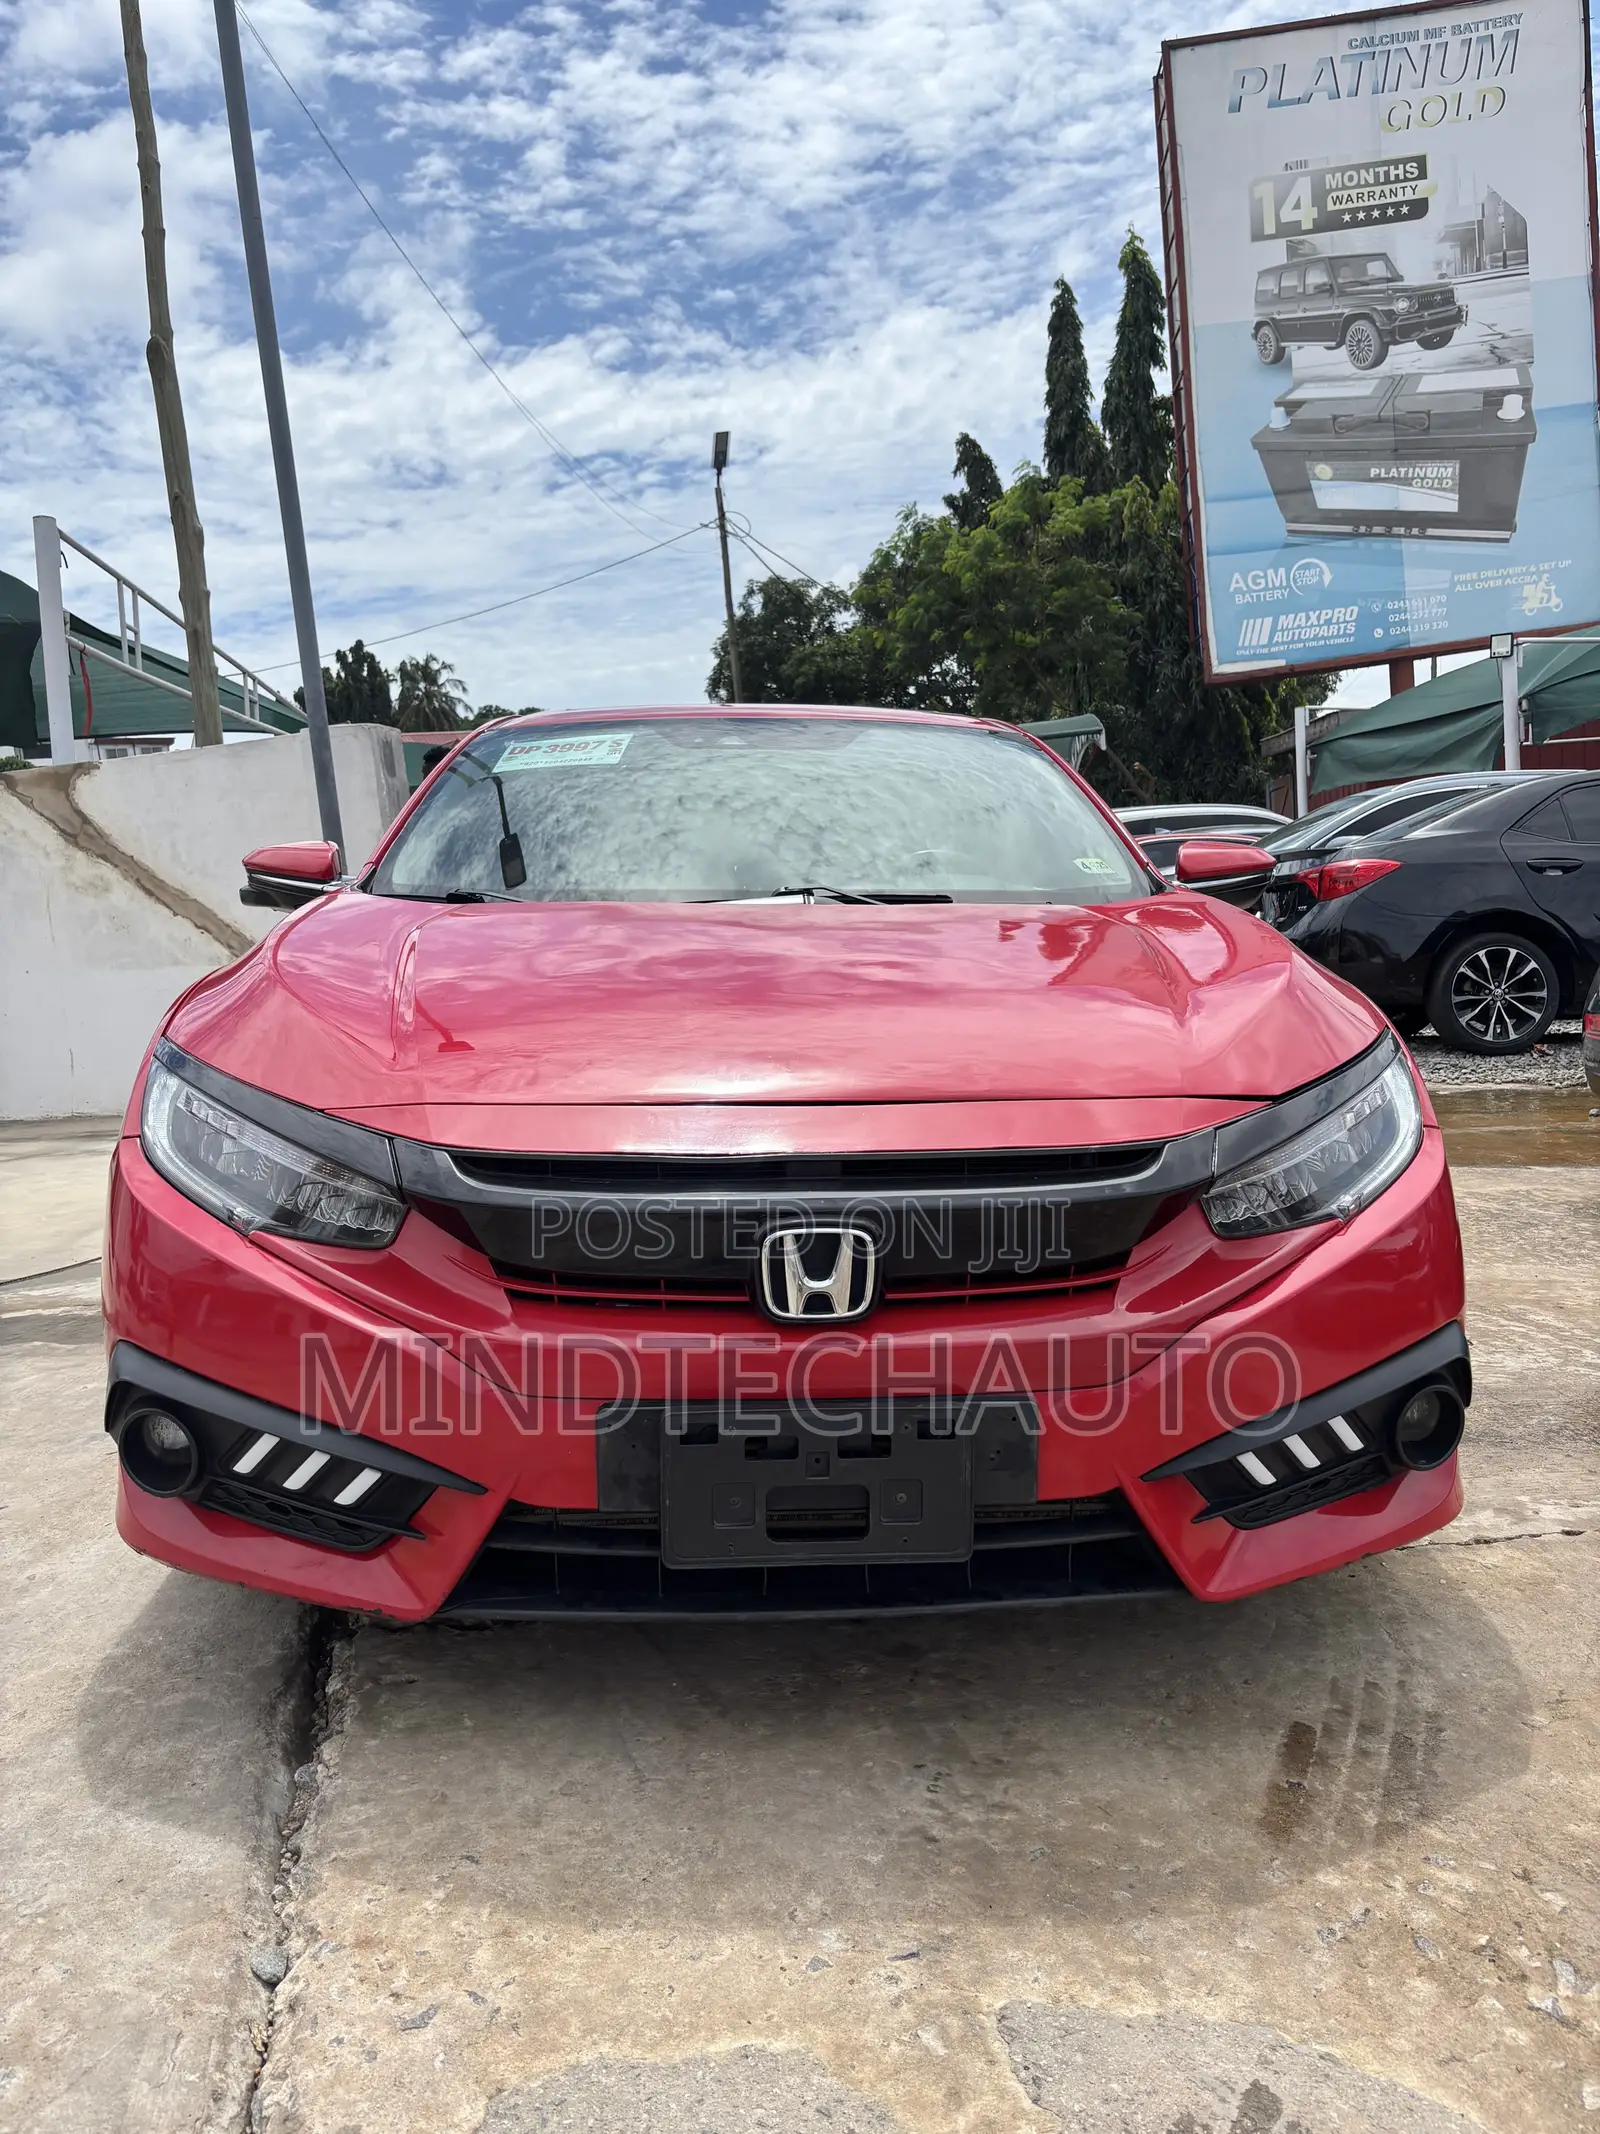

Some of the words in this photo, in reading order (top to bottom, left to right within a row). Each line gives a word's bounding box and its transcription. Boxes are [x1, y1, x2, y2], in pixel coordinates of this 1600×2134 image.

[1347, 28, 1420, 50] CALCIUM
[1423, 26, 1447, 41] MF
[1450, 12, 1524, 37] BATTERY
[1227, 28, 1520, 114] PLATINUM
[1380, 86, 1507, 133] GOLD
[1325, 162, 1419, 190] MONTHS
[1252, 175, 1318, 236] 14
[1331, 184, 1419, 207] WARRANTY
[1370, 467, 1454, 478] PLATINUM
[1412, 478, 1453, 488] GOLD
[1229, 567, 1287, 593] AGM
[1294, 567, 1321, 579] START
[1296, 576, 1320, 586] STOP
[1454, 572, 1478, 582] FREE
[1480, 565, 1527, 578] DELIVERY
[1539, 561, 1556, 571] SET
[1558, 559, 1572, 568] UP
[1454, 584, 1473, 593] ALL
[1475, 580, 1502, 590] OVER
[1504, 575, 1539, 585] ACCRA
[1235, 588, 1290, 605] BATTERY
[1277, 605, 1359, 631] MAXPRO
[1432, 620, 1449, 630] 320
[1272, 622, 1357, 644] AUTOPARTS
[1326, 636, 1356, 645] VEHICLE
[507, 745, 541, 756] DP
[543, 740, 605, 754] 3997
